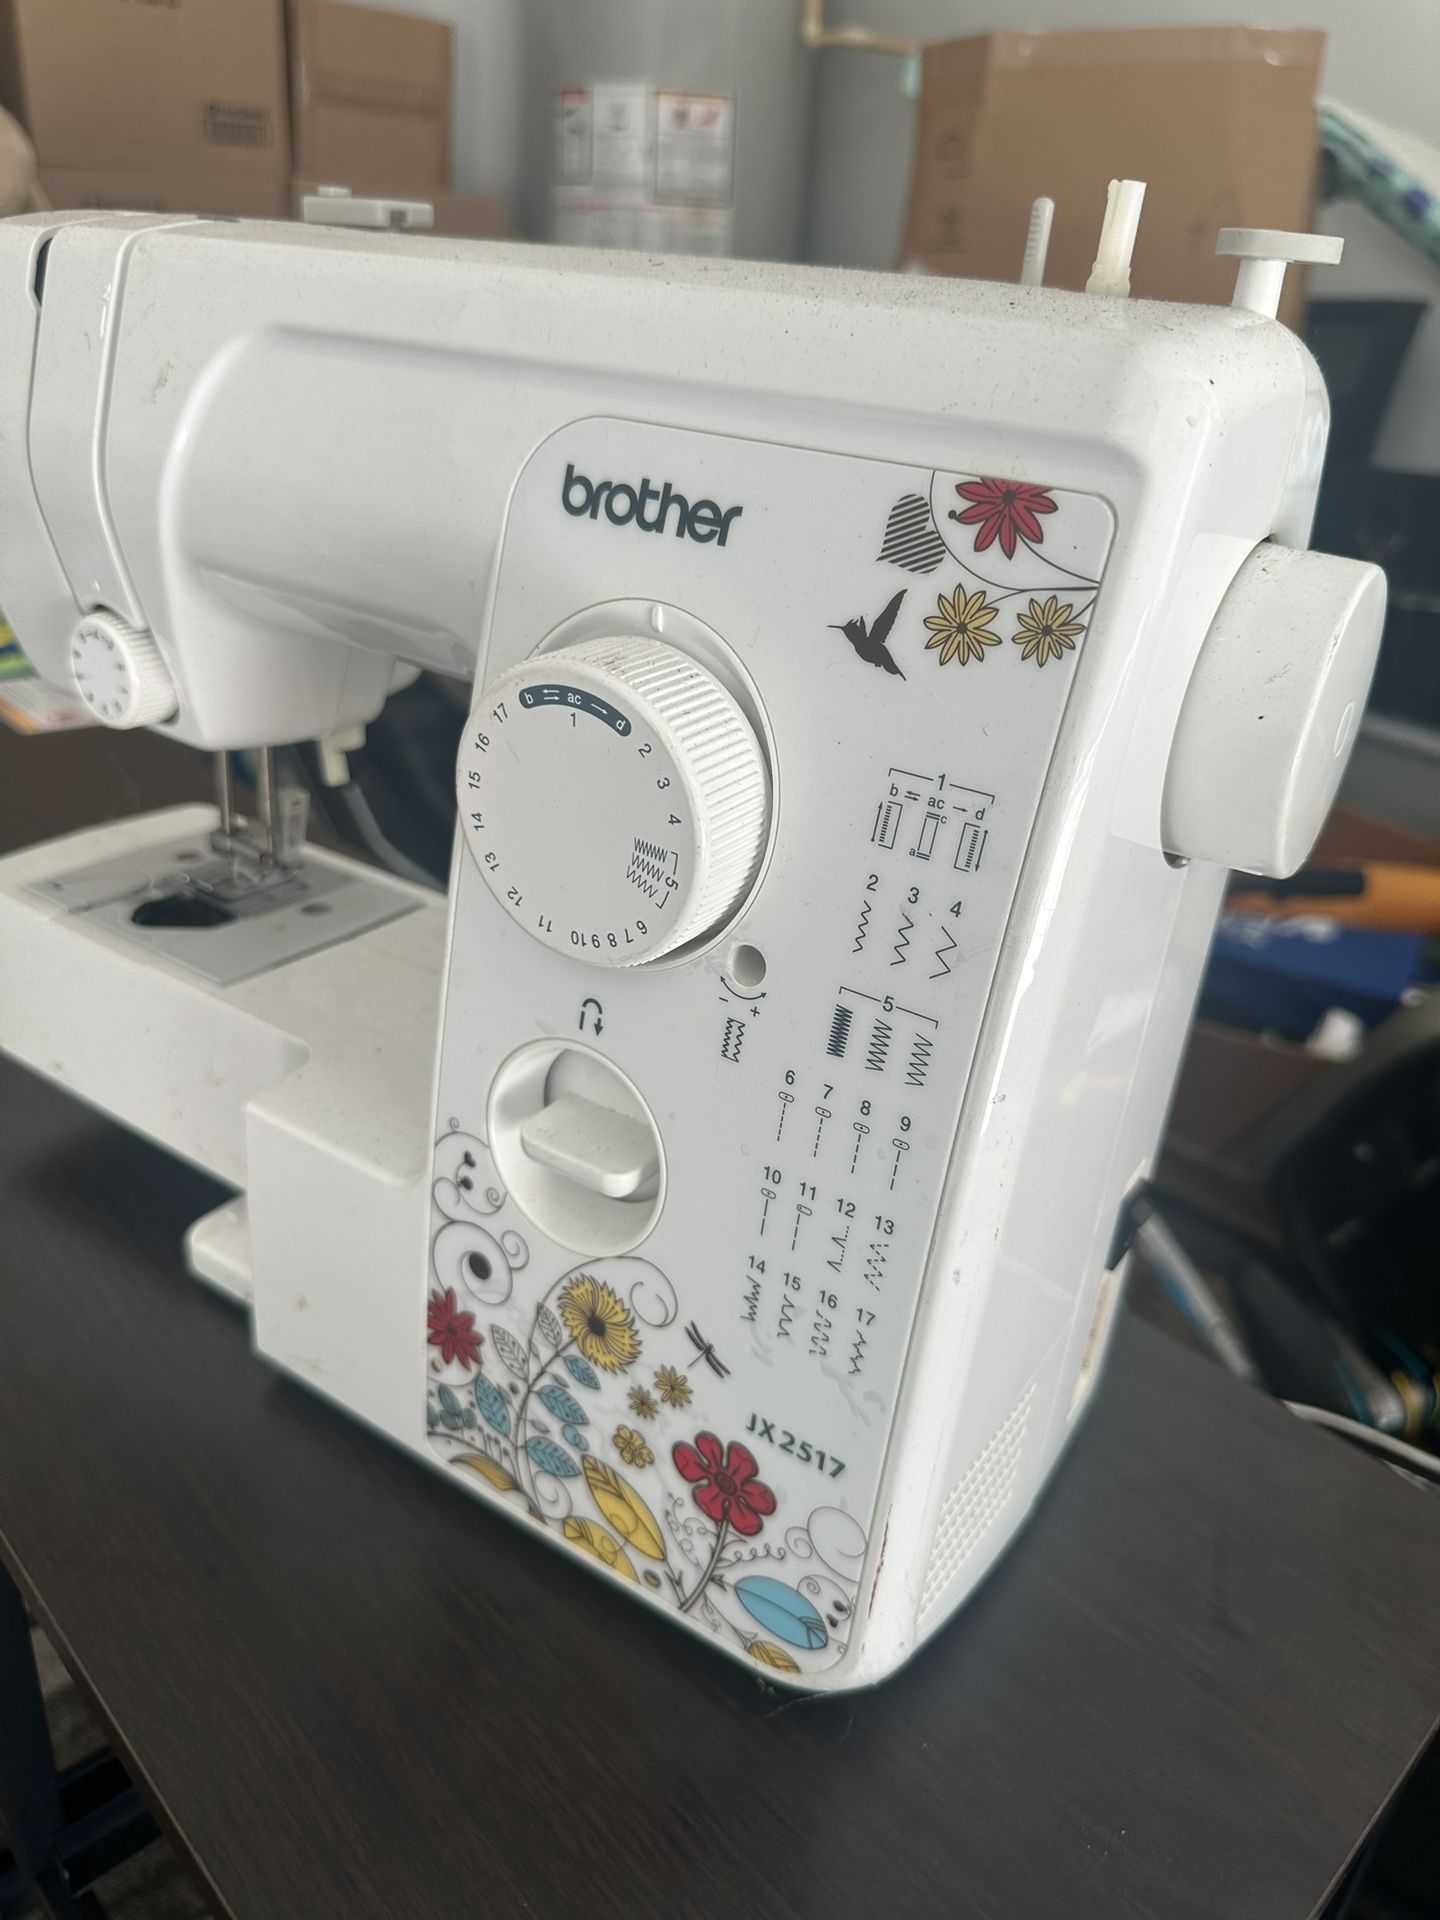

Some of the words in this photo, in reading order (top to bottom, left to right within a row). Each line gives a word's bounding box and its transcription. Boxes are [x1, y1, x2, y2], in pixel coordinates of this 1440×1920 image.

[561, 463, 744, 547] brother
[492, 702, 508, 724] 17
[523, 692, 534, 705] b
[567, 692, 582, 705] ac
[615, 719, 627, 732] d
[570, 712, 576, 728] 1
[474, 732, 490, 753] 16
[638, 743, 652, 759] 2
[468, 771, 481, 789] 15
[656, 777, 671, 790] 3
[937, 773, 946, 791] 1
[889, 783, 899, 797] b
[927, 796, 945, 810] ac
[974, 807, 985, 821] d
[471, 812, 485, 831] 14
[668, 813, 682, 826] 4
[940, 815, 948, 825] c
[908, 847, 916, 857] a
[484, 852, 500, 872] 13
[665, 876, 679, 891] 5
[507, 886, 523, 907] 12
[866, 873, 879, 892] 2
[907, 886, 920, 904] 3
[949, 900, 962, 918] 4
[538, 915, 552, 933] 11
[636, 920, 648, 935] 6
[570, 930, 587, 947] 10
[591, 933, 601, 949] 9
[606, 932, 618, 948] 8
[624, 928, 634, 944] 7
[882, 995, 895, 1013] 5
[785, 1069, 796, 1086] 6
[823, 1083, 834, 1100] 7
[860, 1099, 872, 1116] 8
[899, 1115, 912, 1132] 9
[763, 1165, 782, 1185] 10
[799, 1182, 817, 1201] 11
[837, 1198, 856, 1219] 12
[875, 1215, 895, 1235] 13
[749, 1255, 766, 1274] 14
[784, 1272, 801, 1291] 15
[819, 1290, 838, 1309] 16
[856, 1308, 876, 1326] 17
[745, 1413, 847, 1479] JX2517
